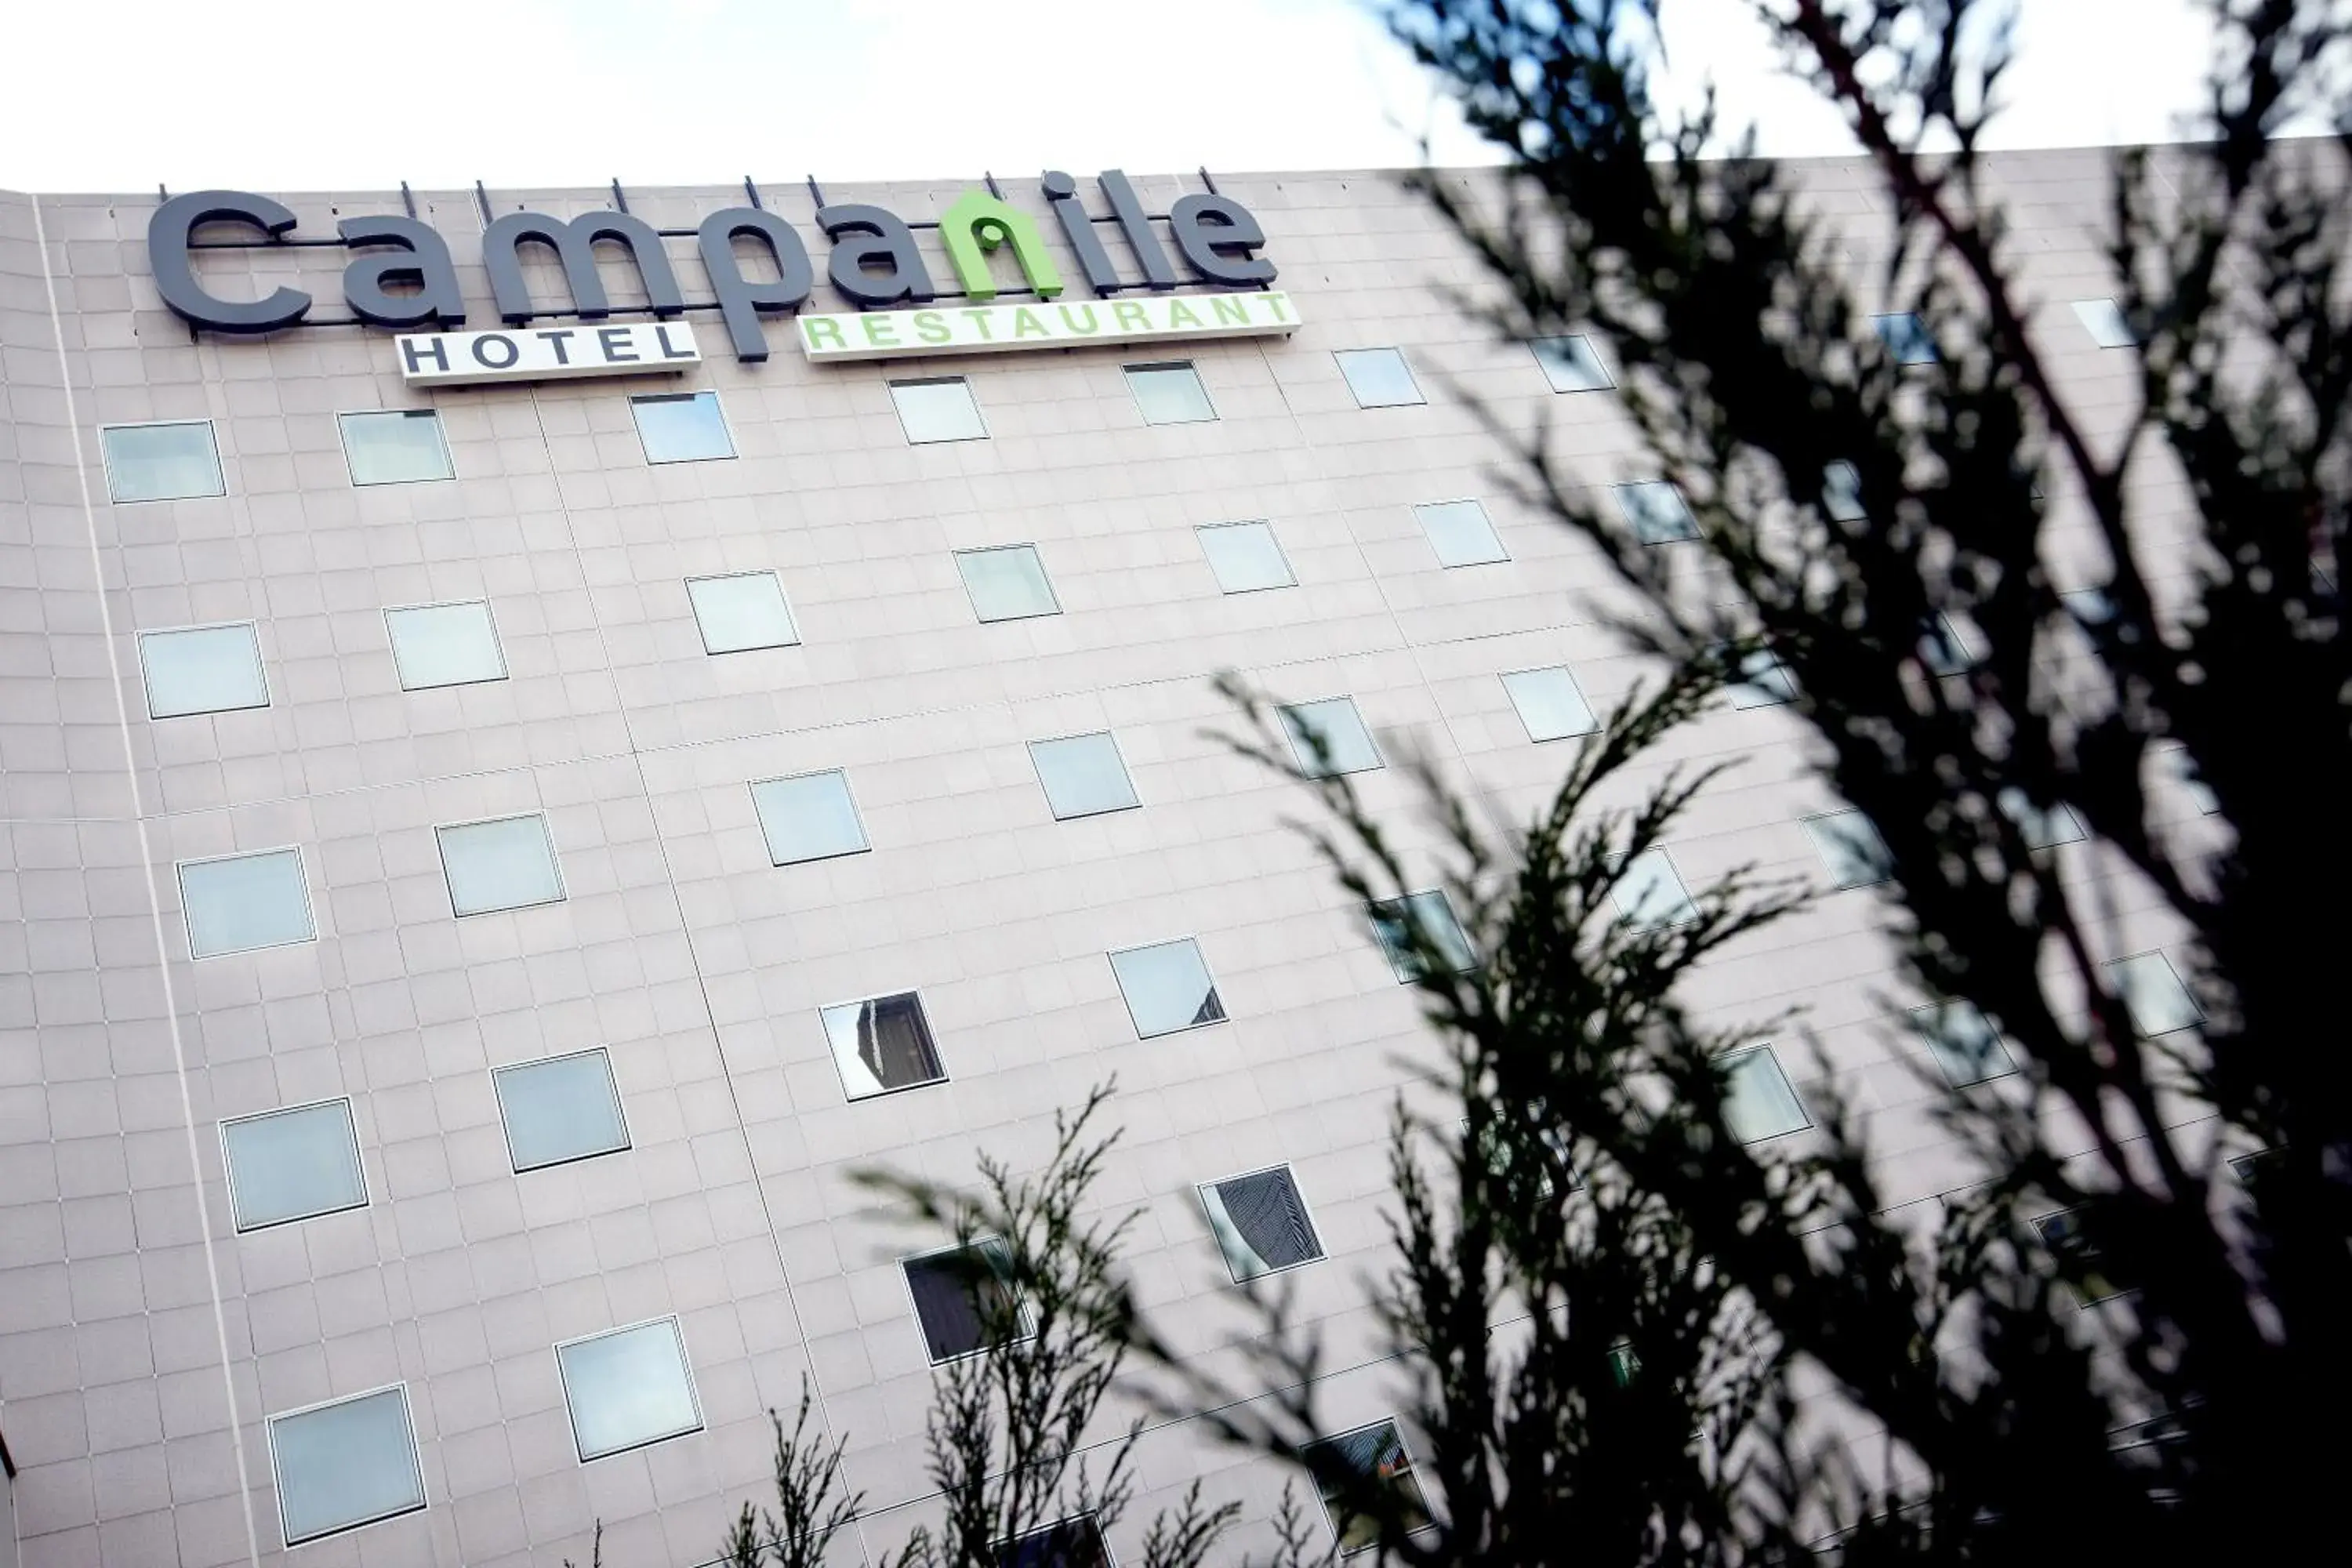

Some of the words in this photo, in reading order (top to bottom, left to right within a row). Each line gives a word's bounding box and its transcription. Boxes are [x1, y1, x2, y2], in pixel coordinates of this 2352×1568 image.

[147, 169, 1279, 363] Campanile
[401, 325, 695, 373] HOTEL
[802, 292, 1291, 351] RESTAURANT
